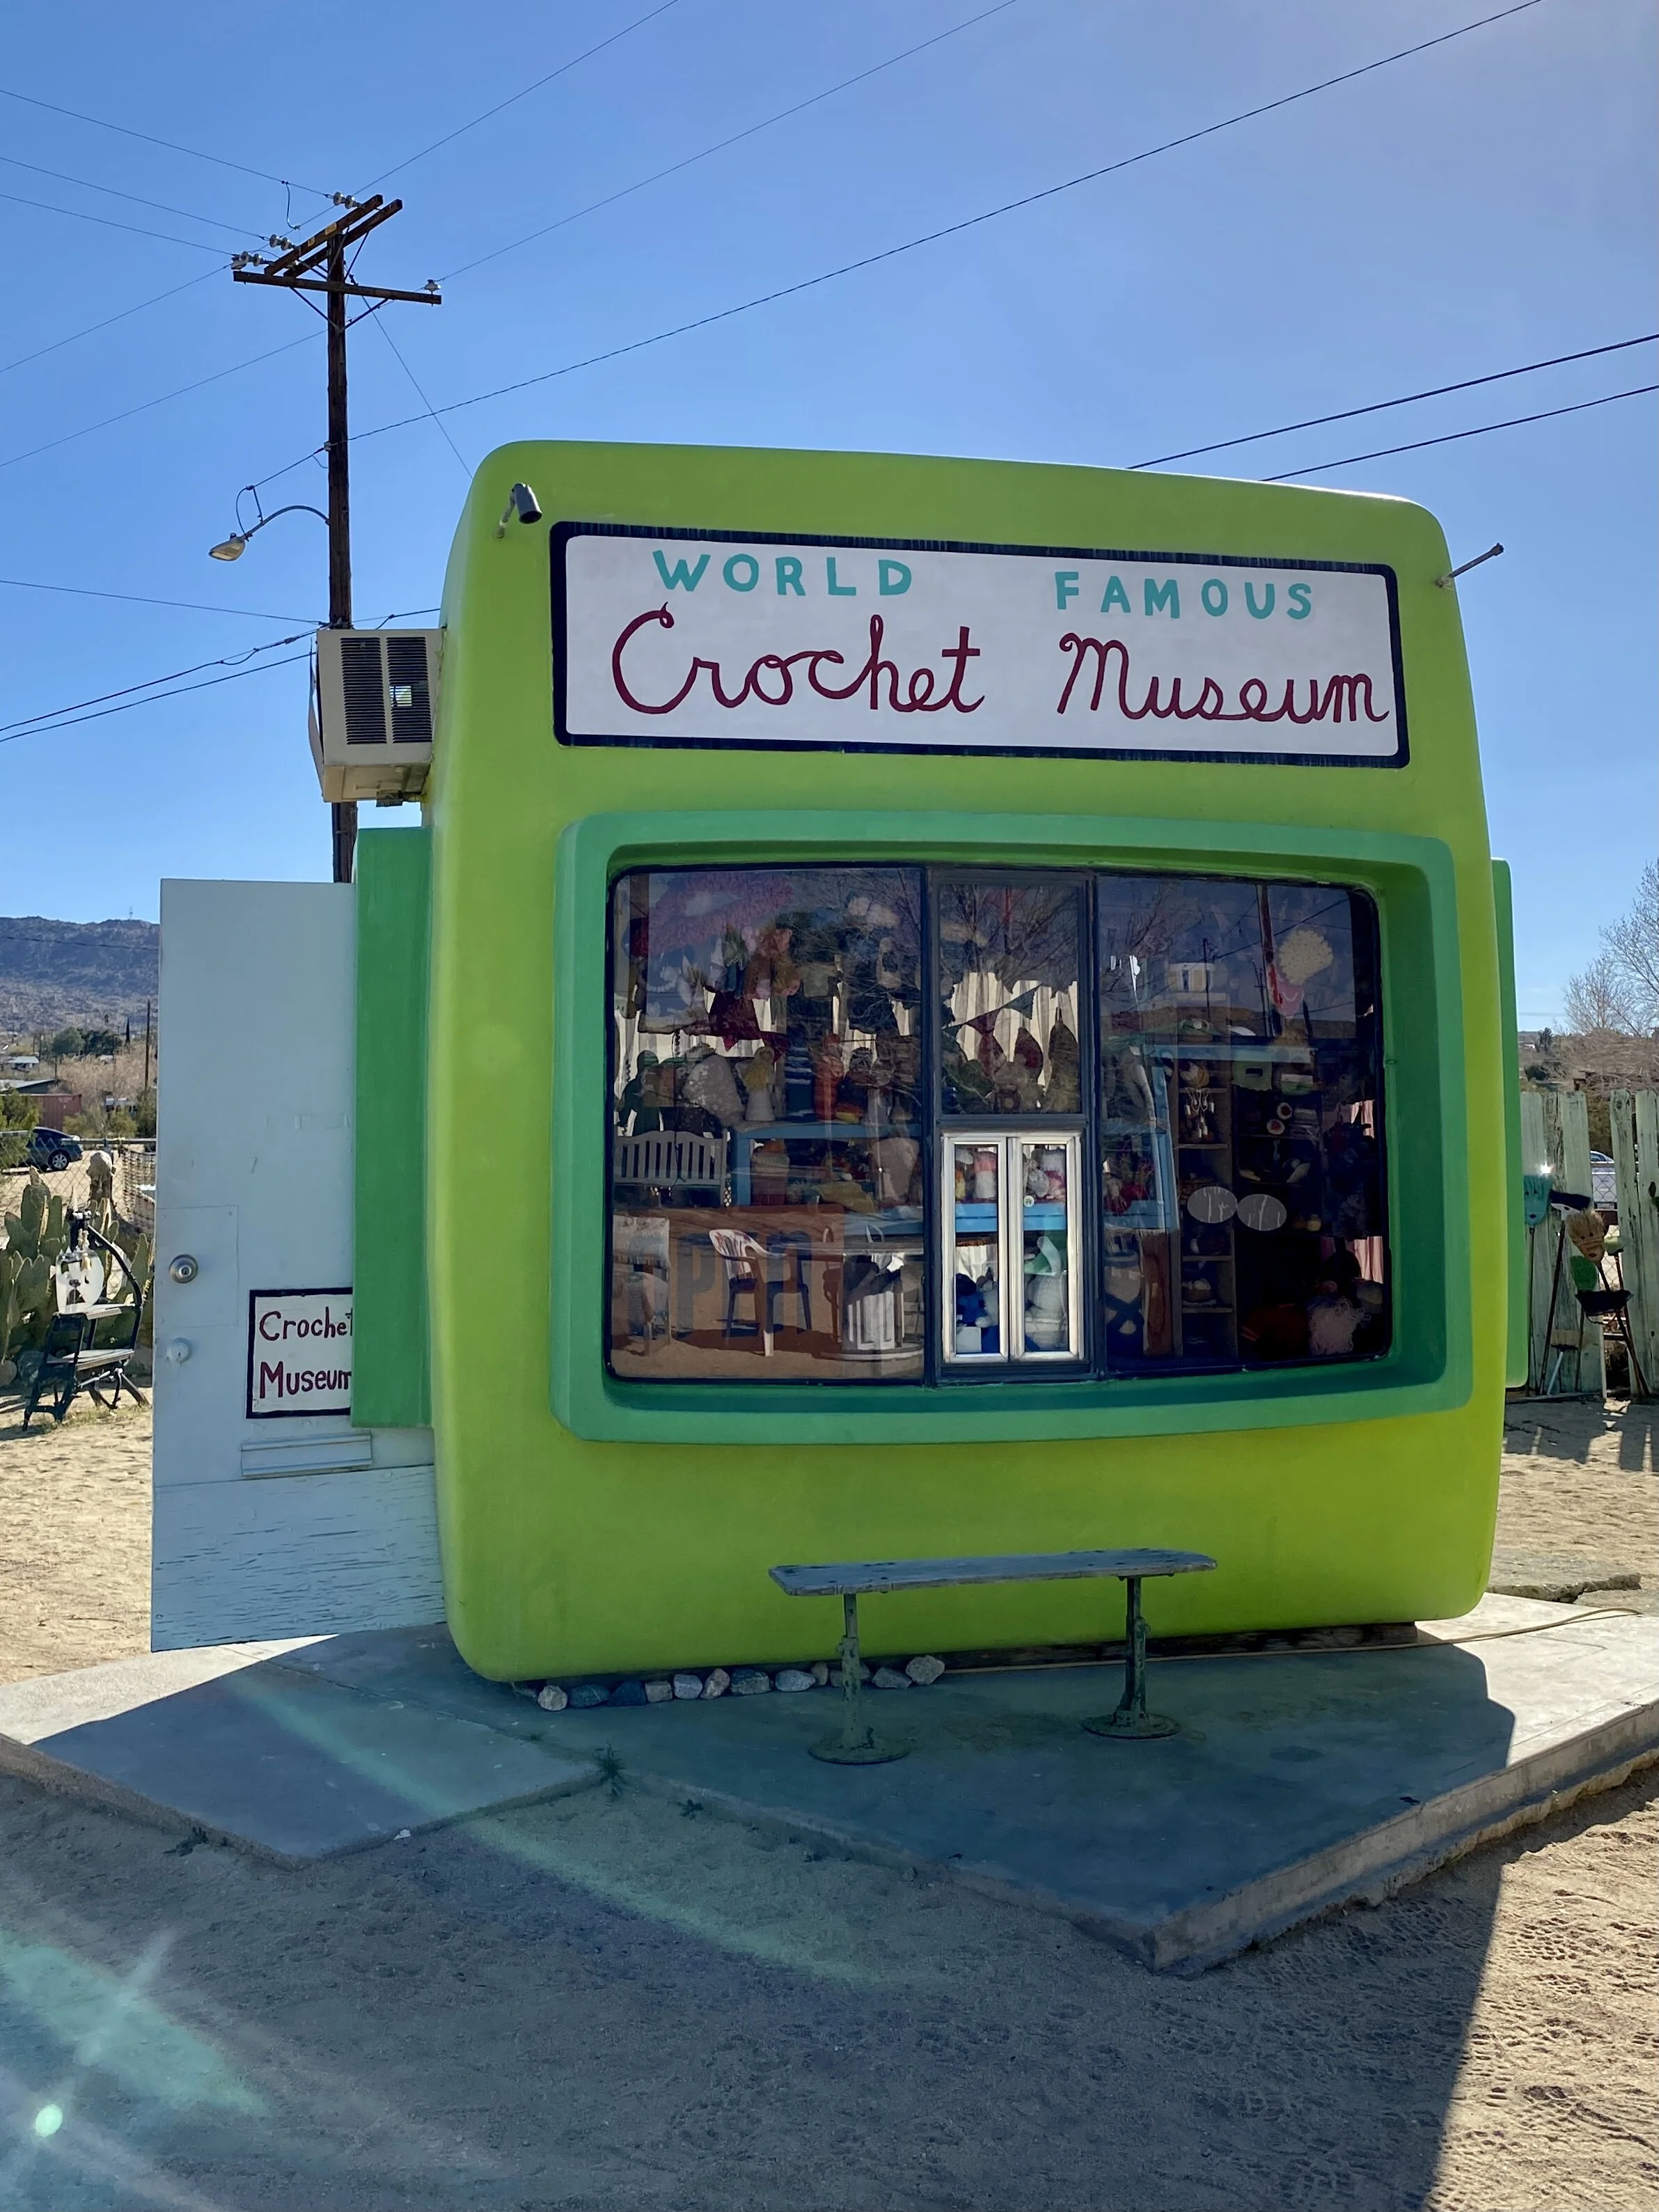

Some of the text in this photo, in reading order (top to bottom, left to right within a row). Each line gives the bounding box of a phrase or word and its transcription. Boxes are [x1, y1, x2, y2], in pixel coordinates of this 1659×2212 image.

[652, 549, 1313, 620] WORLD FAMOUS
[611, 602, 1390, 724] Crochet Museum
